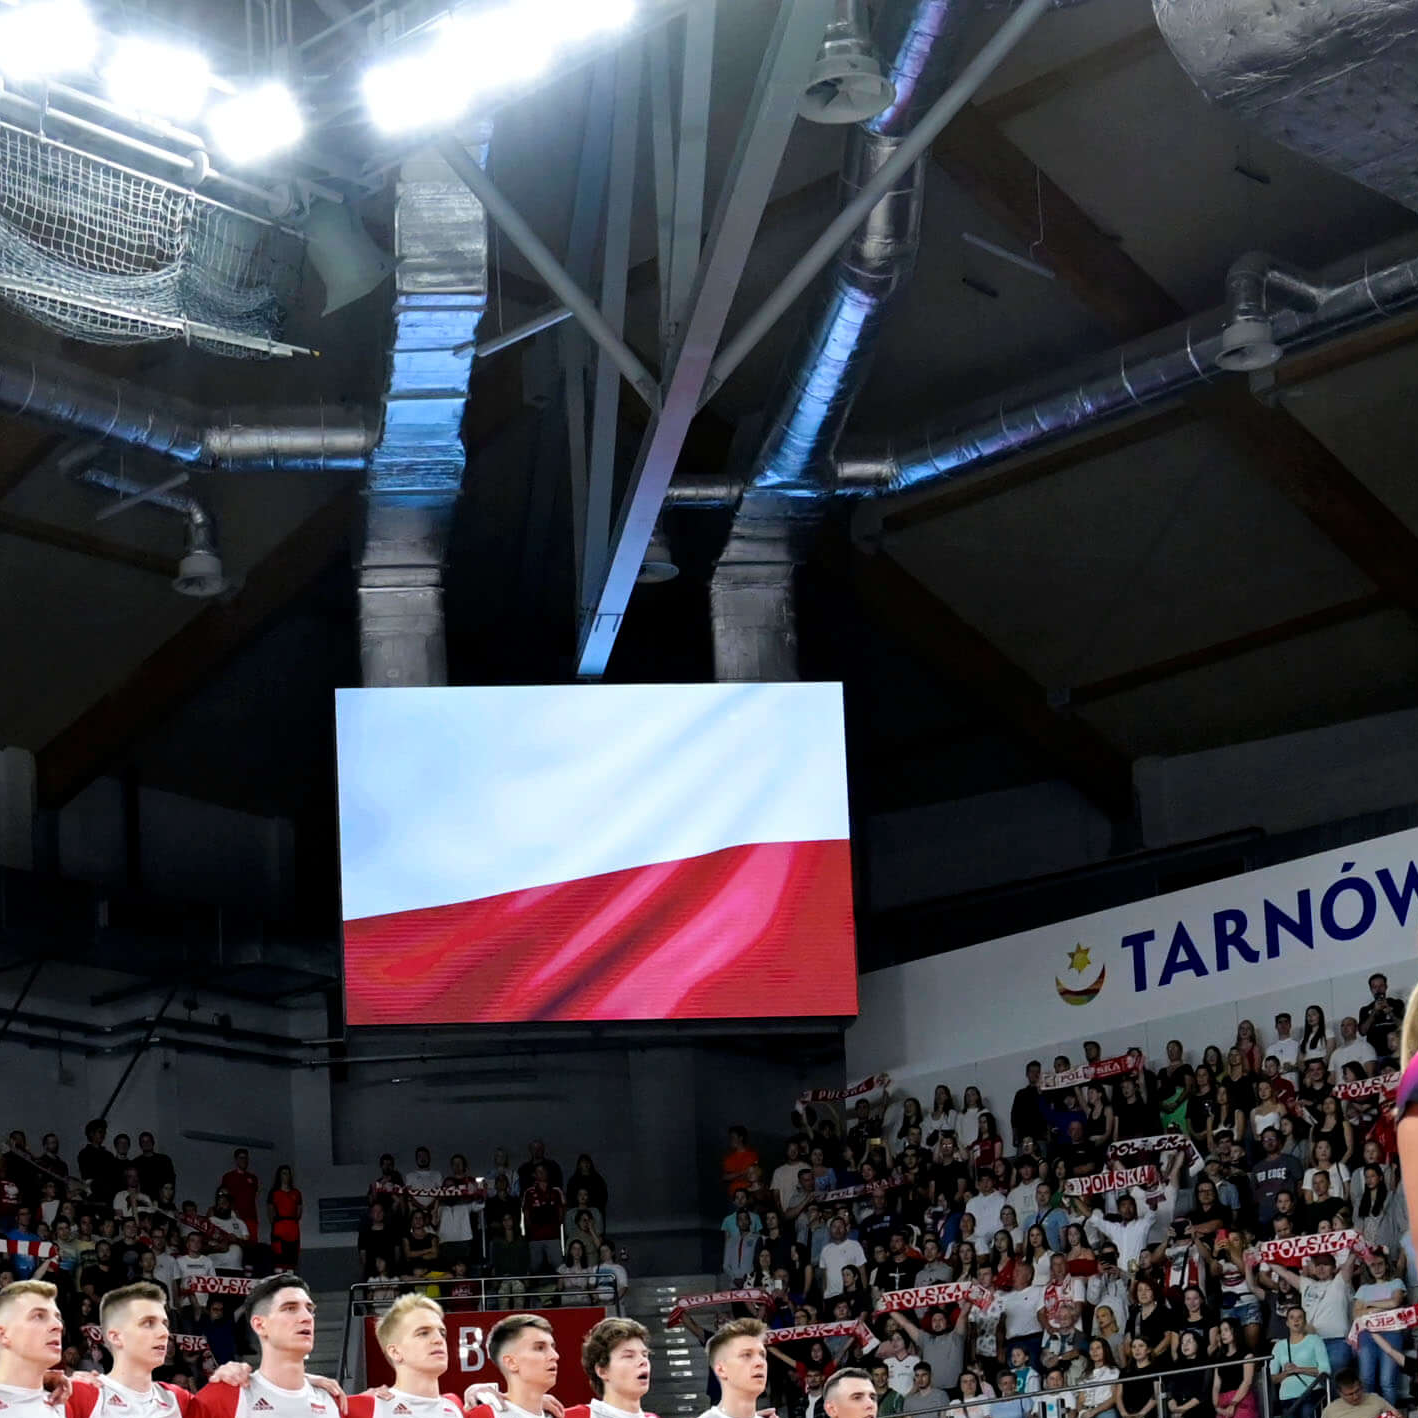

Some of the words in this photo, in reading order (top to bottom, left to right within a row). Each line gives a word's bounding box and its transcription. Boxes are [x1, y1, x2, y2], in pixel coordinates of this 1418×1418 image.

[1083, 1165, 1148, 1194] POLSKA
[1266, 1232, 1347, 1259] POLSKA
[887, 1284, 966, 1309] POLSKA
[767, 1323, 843, 1344] POLSKA
